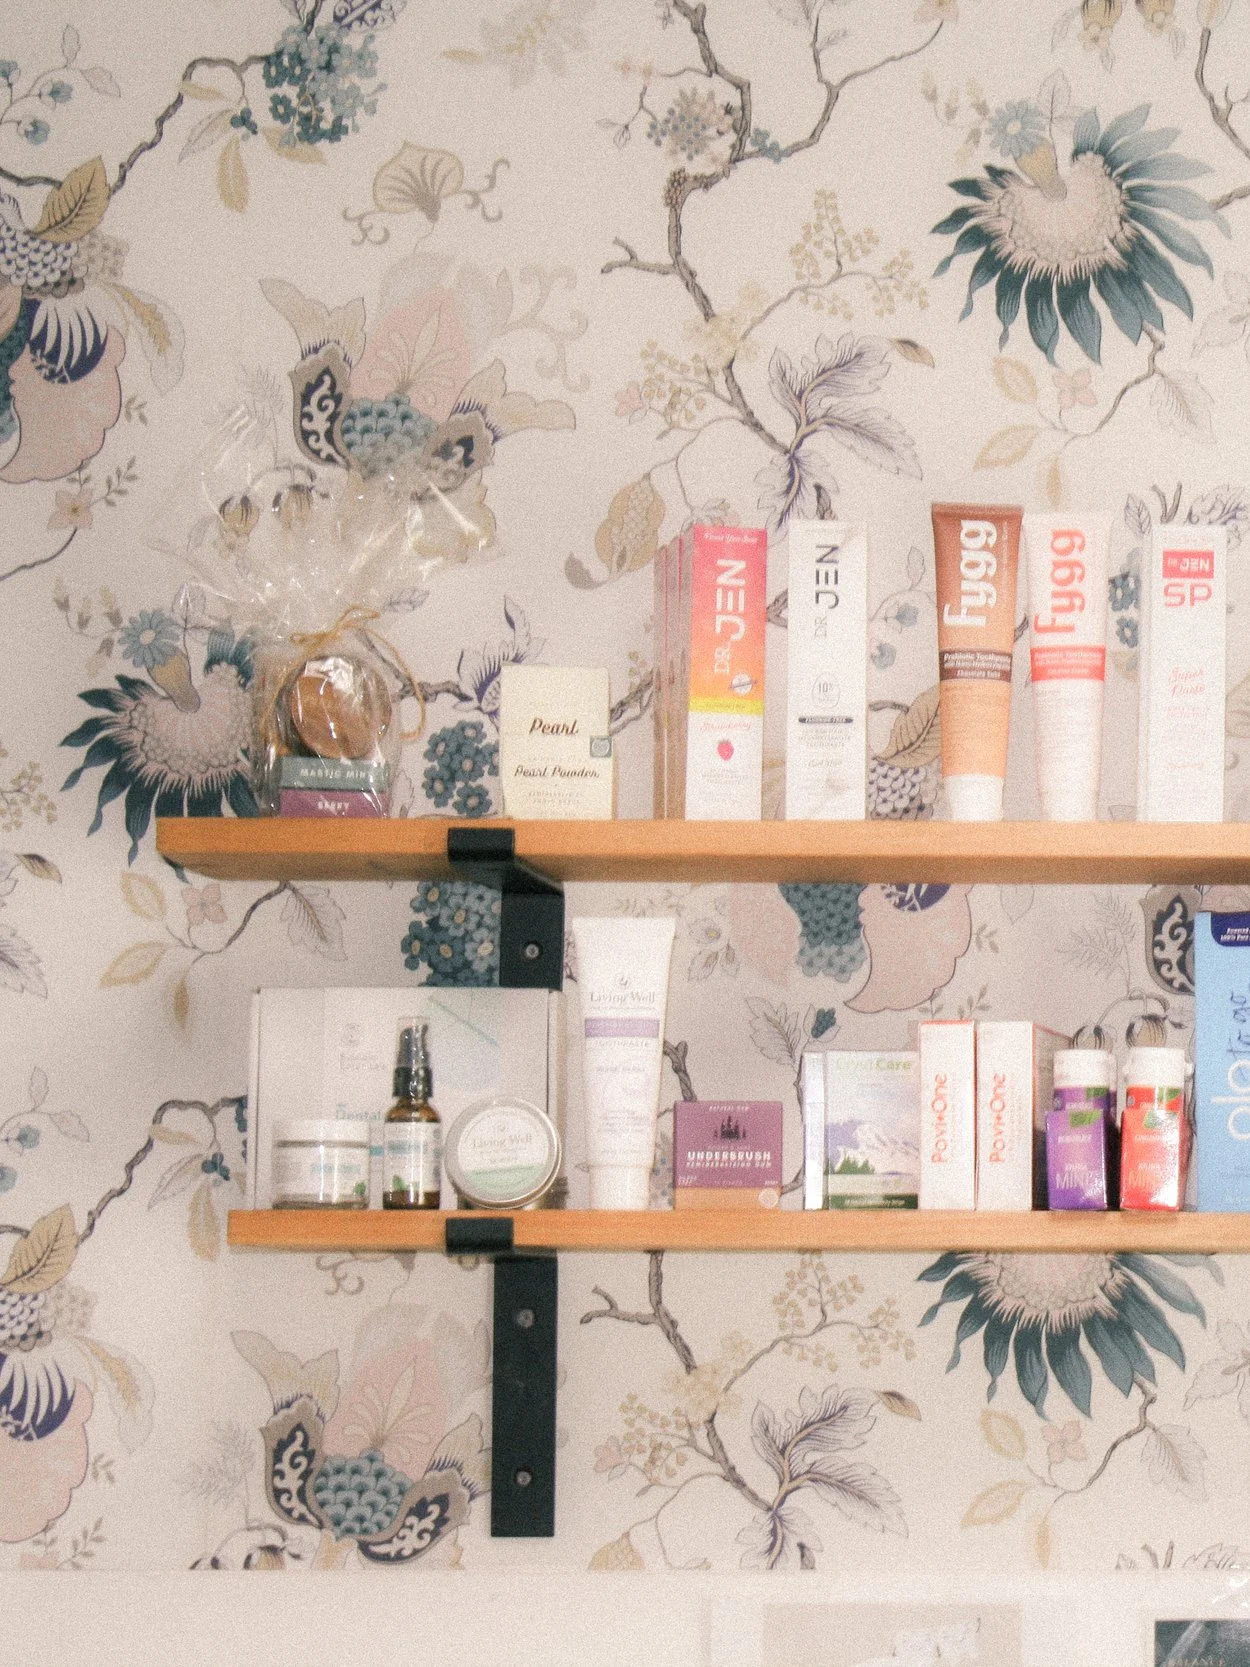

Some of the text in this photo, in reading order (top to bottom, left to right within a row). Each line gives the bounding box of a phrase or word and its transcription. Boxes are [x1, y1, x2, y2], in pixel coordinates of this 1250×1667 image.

[1180, 557, 1210, 572] JEN
[715, 558, 747, 642] JEN
[1163, 582, 1213, 608] SP
[300, 769, 340, 779] MASTIC
[590, 991, 656, 1006] Living Well
[687, 1150, 771, 1161] UNDERBRUSH
